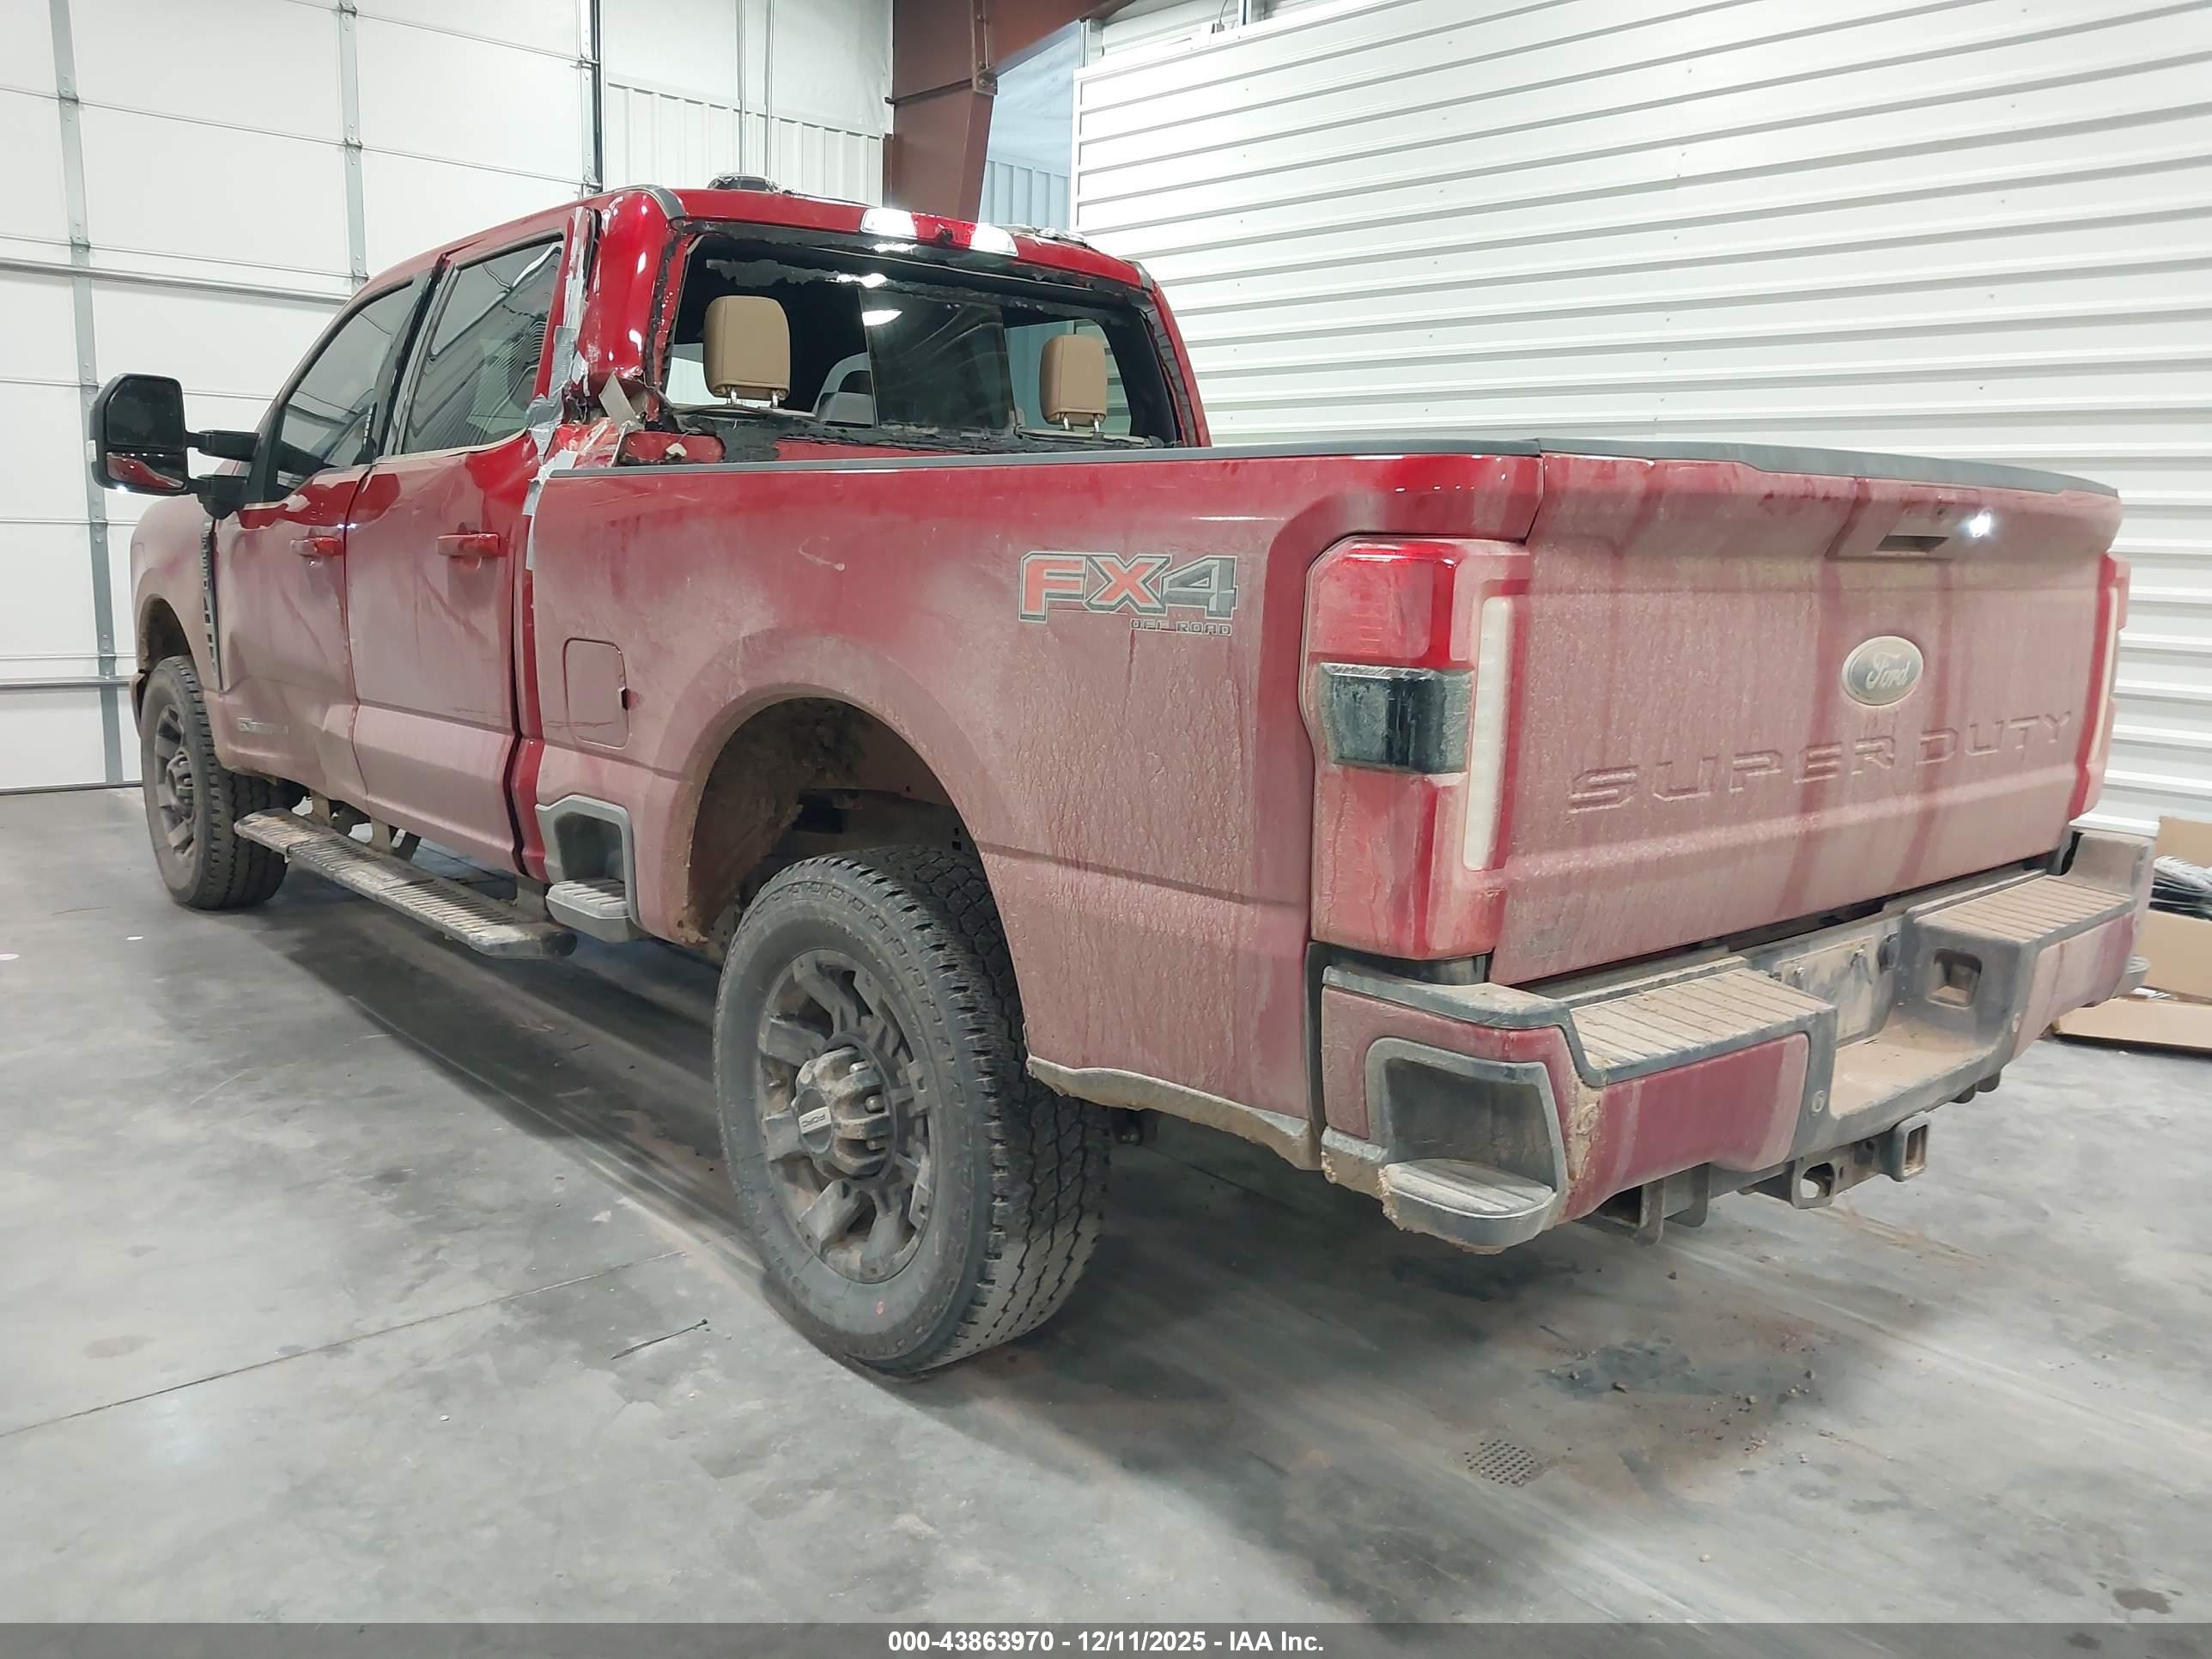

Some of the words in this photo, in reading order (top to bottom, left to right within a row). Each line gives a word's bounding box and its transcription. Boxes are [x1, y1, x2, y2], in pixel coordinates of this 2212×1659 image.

[1019, 552, 1238, 623] FX4
[1130, 618, 1170, 631] OFF
[1176, 620, 1232, 636] ROAD
[1866, 652, 1911, 690] Ford
[1566, 735, 1897, 814] SUPER
[1916, 710, 2072, 765] DUTY
